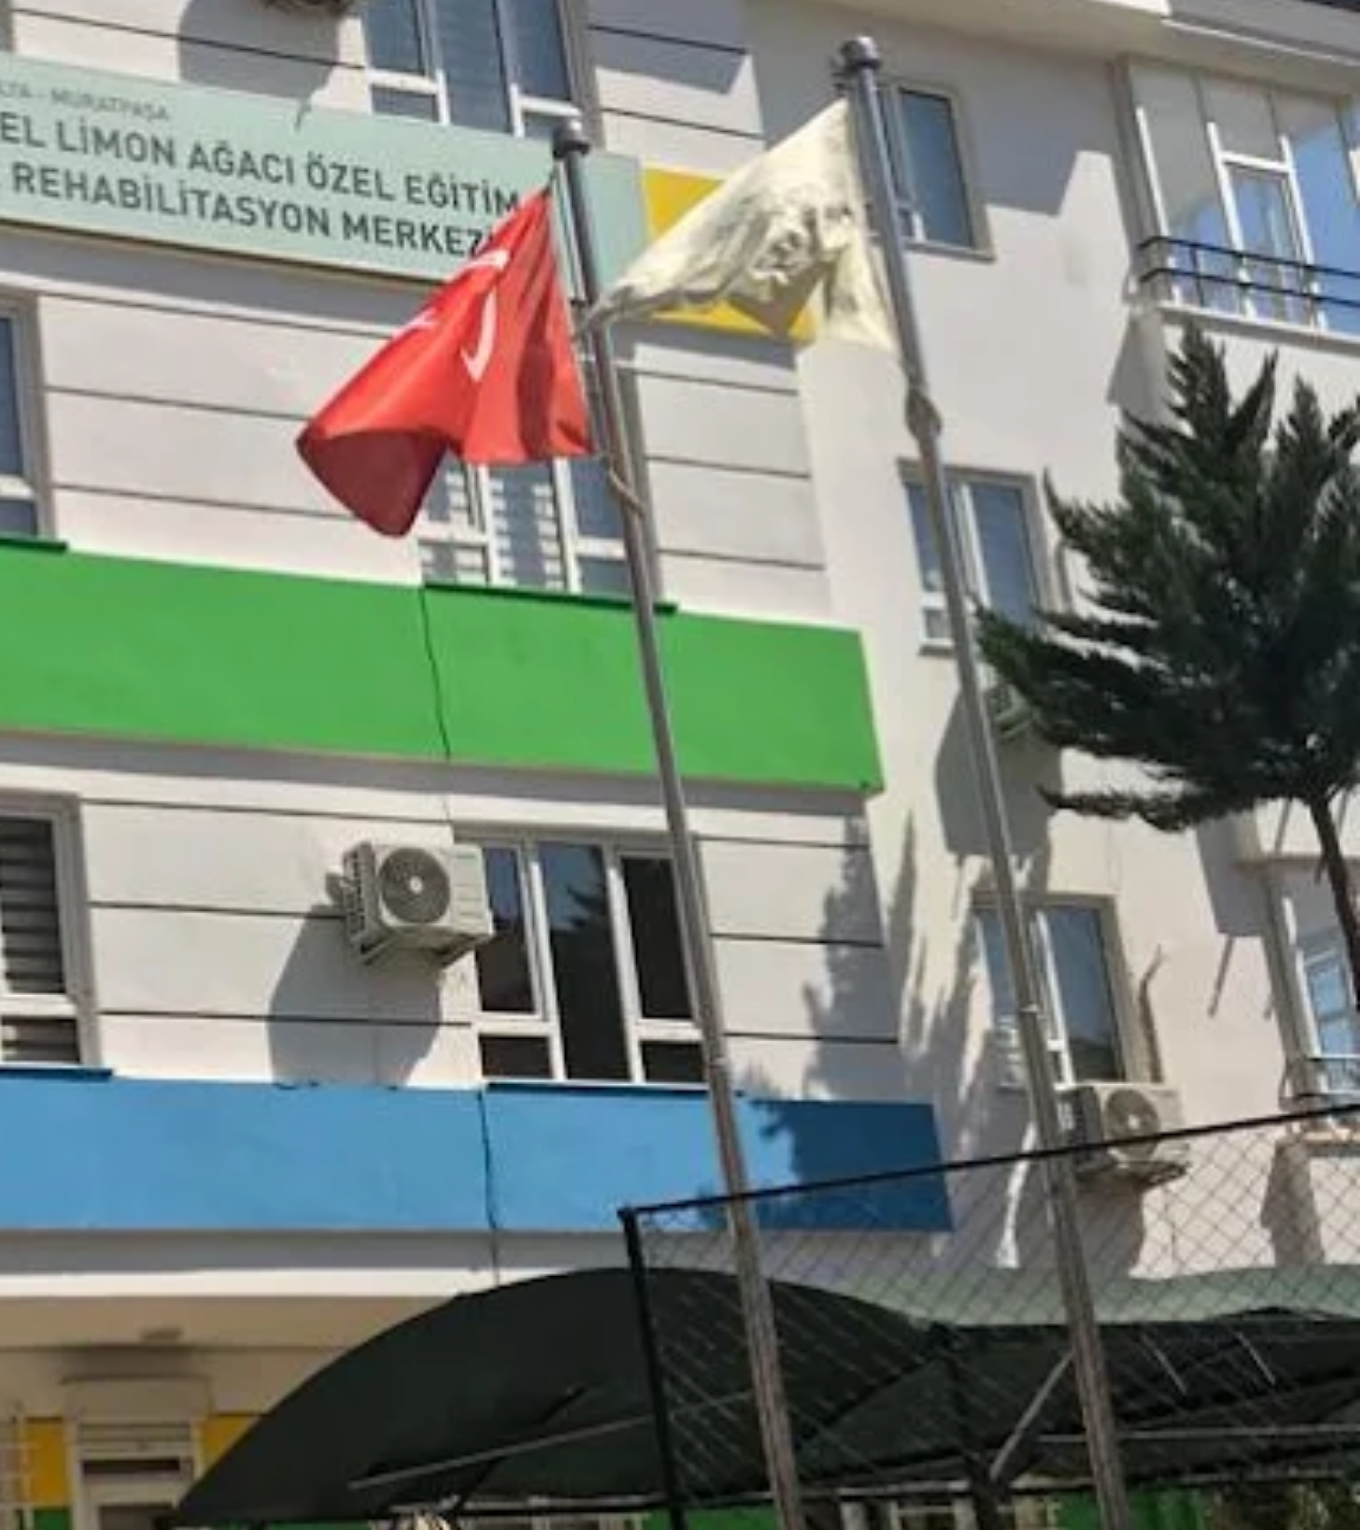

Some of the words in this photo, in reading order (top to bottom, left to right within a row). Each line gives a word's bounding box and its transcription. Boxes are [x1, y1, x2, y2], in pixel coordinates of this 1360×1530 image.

[52, 90, 168, 120] MURATPAŞA
[13, 161, 331, 237] REHABİLİTASYON
[56, 117, 175, 167] LİMON
[188, 140, 296, 185] AĞACI
[307, 152, 396, 201] ÖZEL
[405, 173, 520, 215] EĞİTİM
